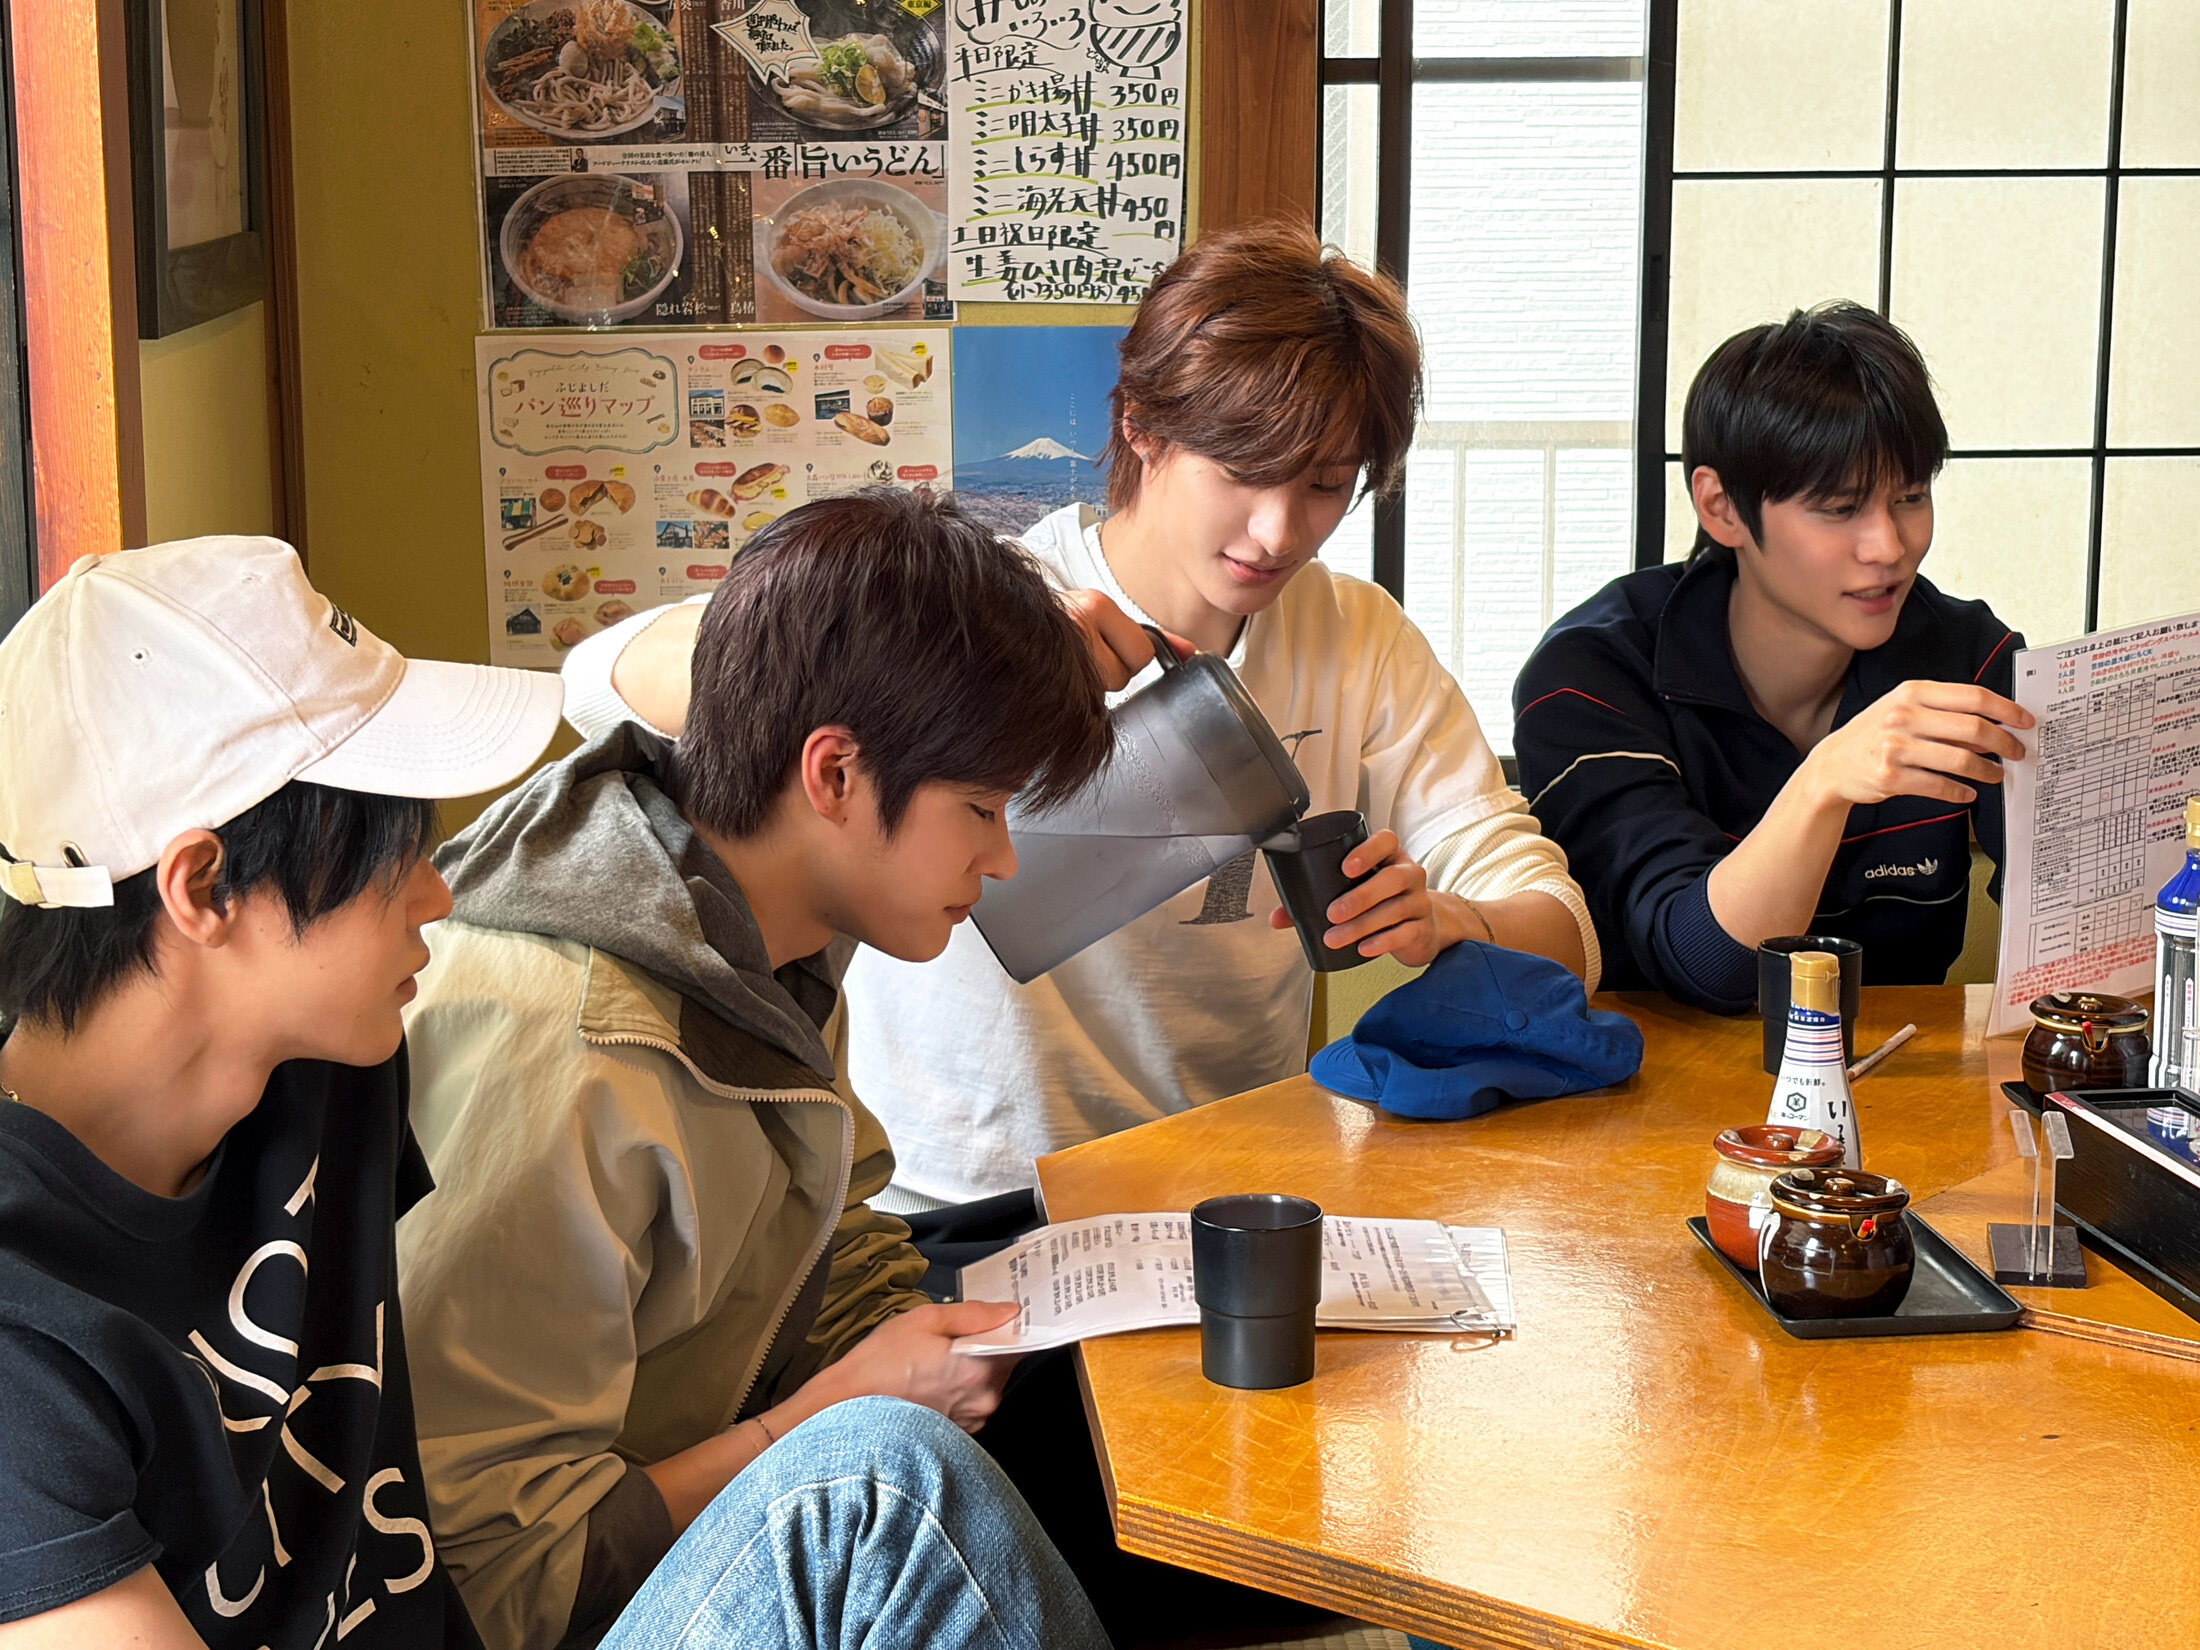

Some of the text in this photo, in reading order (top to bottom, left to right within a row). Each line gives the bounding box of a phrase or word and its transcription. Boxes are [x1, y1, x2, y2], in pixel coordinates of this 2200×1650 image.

[1110, 83, 1178, 106] 350円
[1113, 118, 1179, 142] 350円
[1106, 152, 1180, 181] 450円
[556, 381, 609, 393] ふじよしだ
[514, 395, 656, 417] パン巡りマップ
[1864, 864, 1915, 878] adidas
